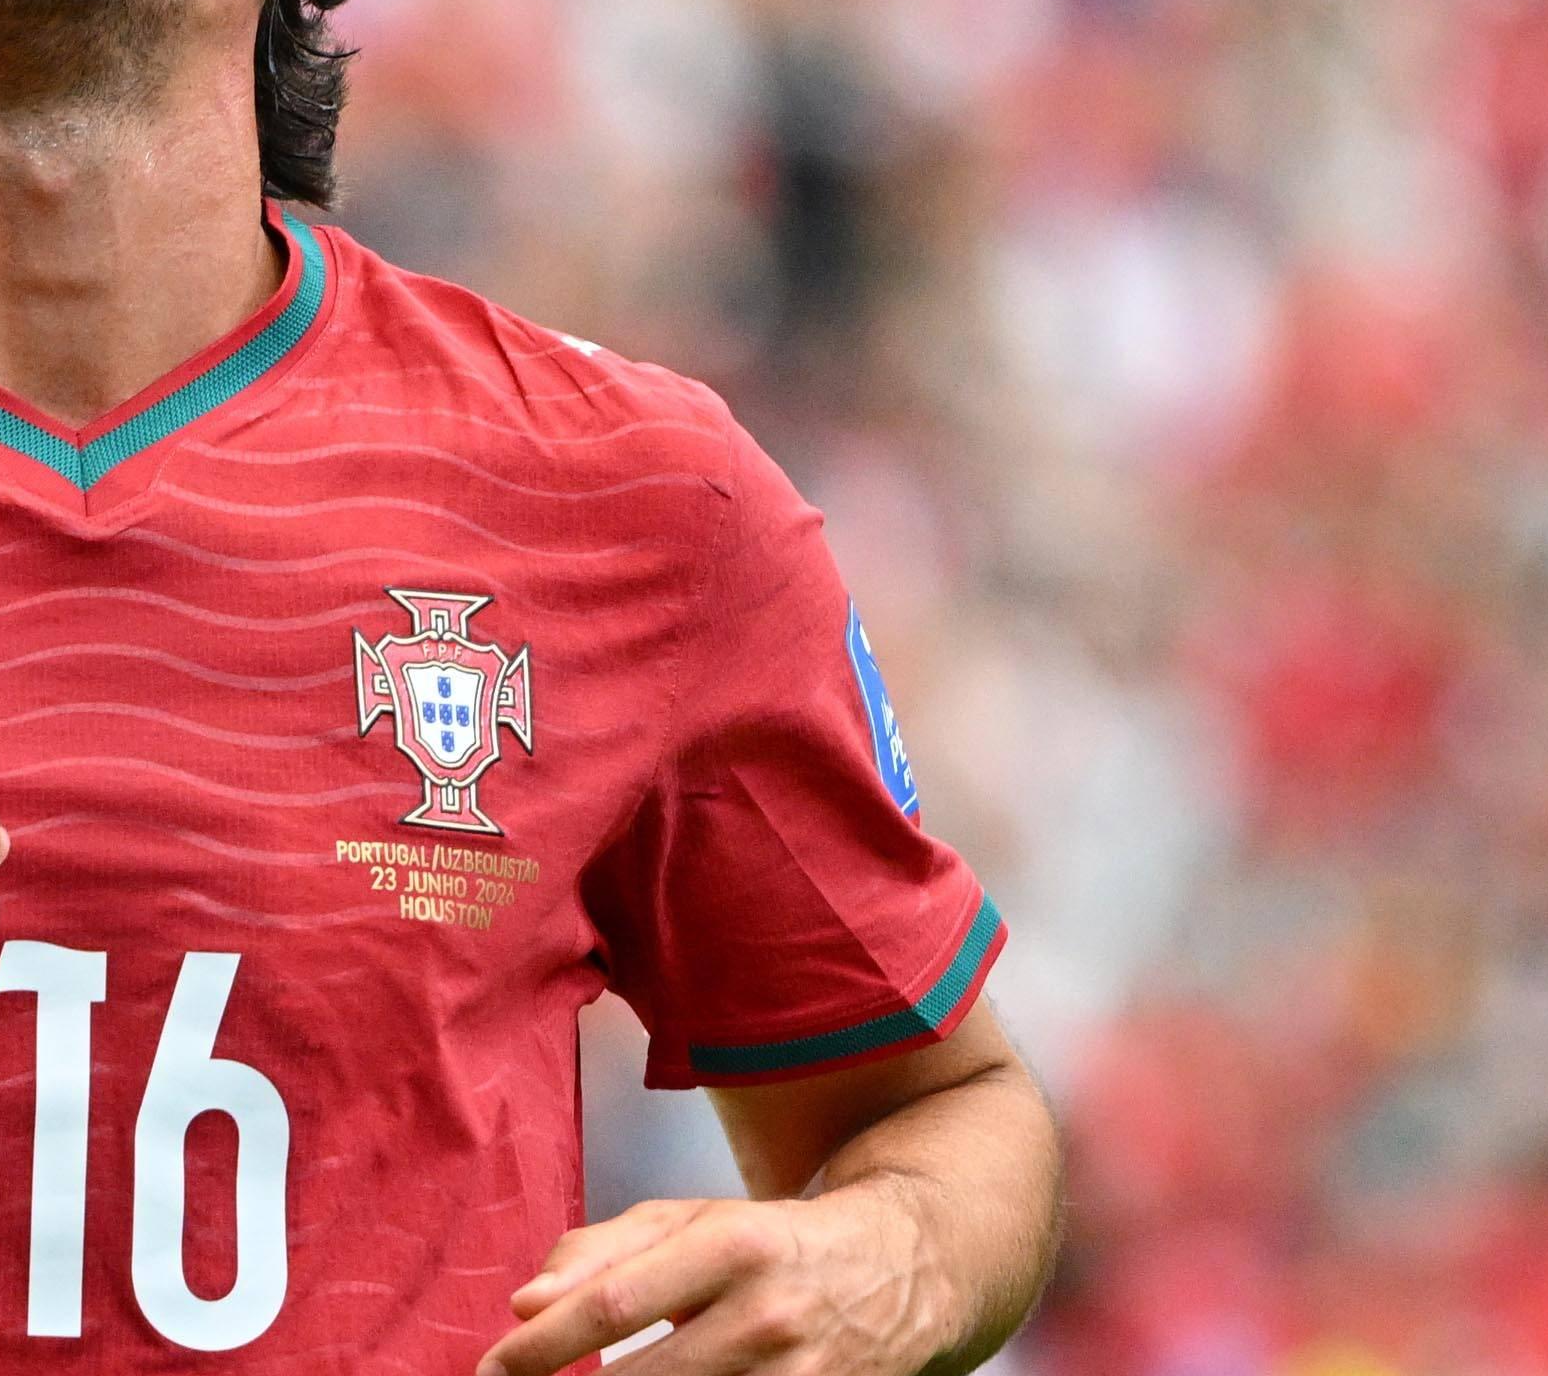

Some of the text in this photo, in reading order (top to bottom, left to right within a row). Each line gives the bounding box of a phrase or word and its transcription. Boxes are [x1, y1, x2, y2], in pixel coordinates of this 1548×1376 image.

[370, 866, 397, 891] 23
[404, 870, 467, 898] JUNHO
[399, 895, 493, 930] HOUSTON
